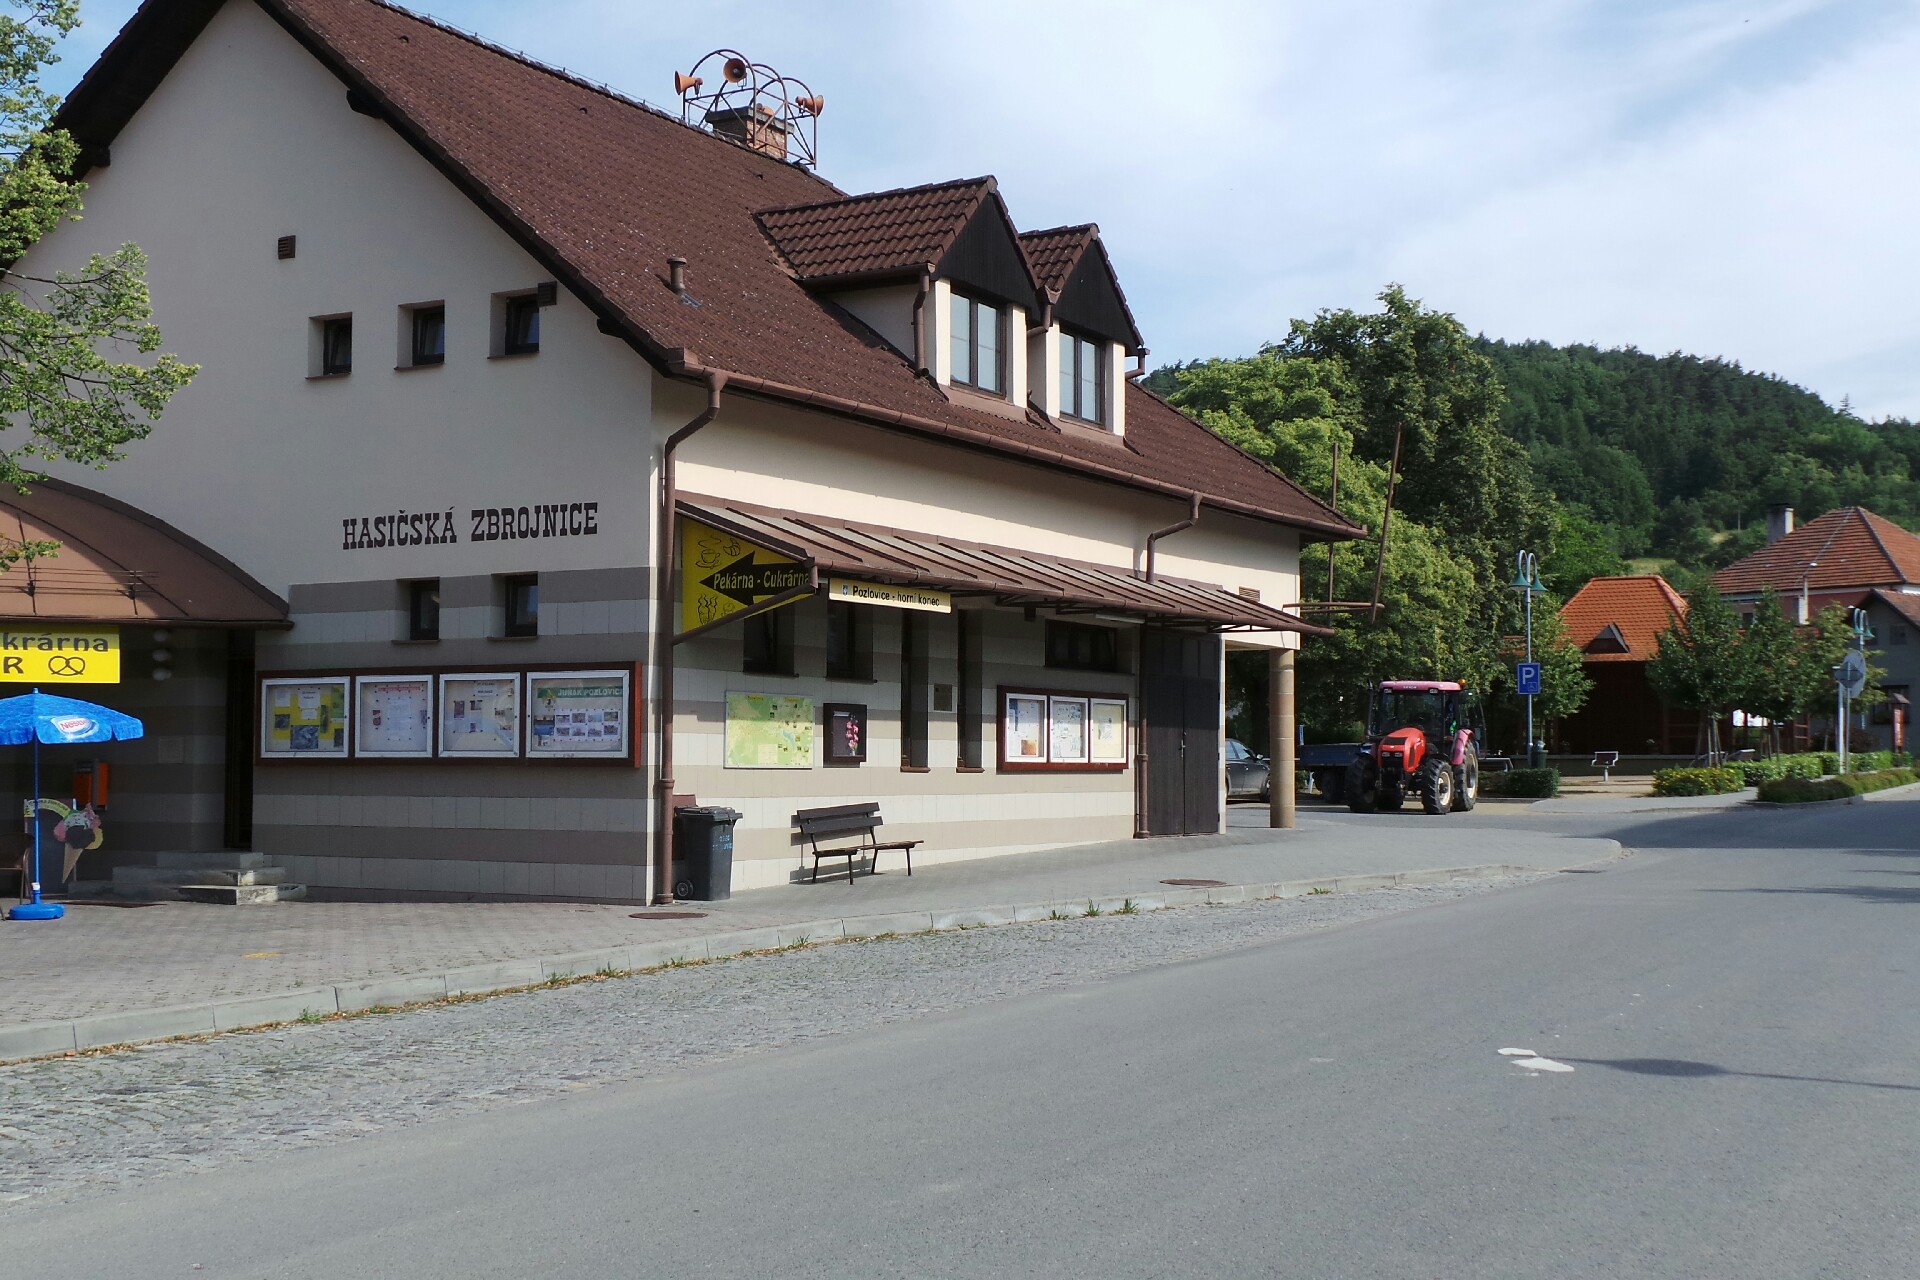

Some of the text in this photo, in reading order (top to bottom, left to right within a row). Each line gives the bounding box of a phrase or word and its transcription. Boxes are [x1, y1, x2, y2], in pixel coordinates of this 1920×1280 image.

[343, 502, 598, 550] HASIČSKÁ ZBROJNICE
[713, 572, 754, 590] Pekárna
[852, 585, 890, 601] Pozlovice
[897, 590, 917, 604] horní
[918, 593, 940, 606] konec
[2, 632, 109, 652] krárna
[3, 656, 24, 674] R
[1522, 667, 1535, 685] P
[584, 687, 623, 696] POZLOVIC
